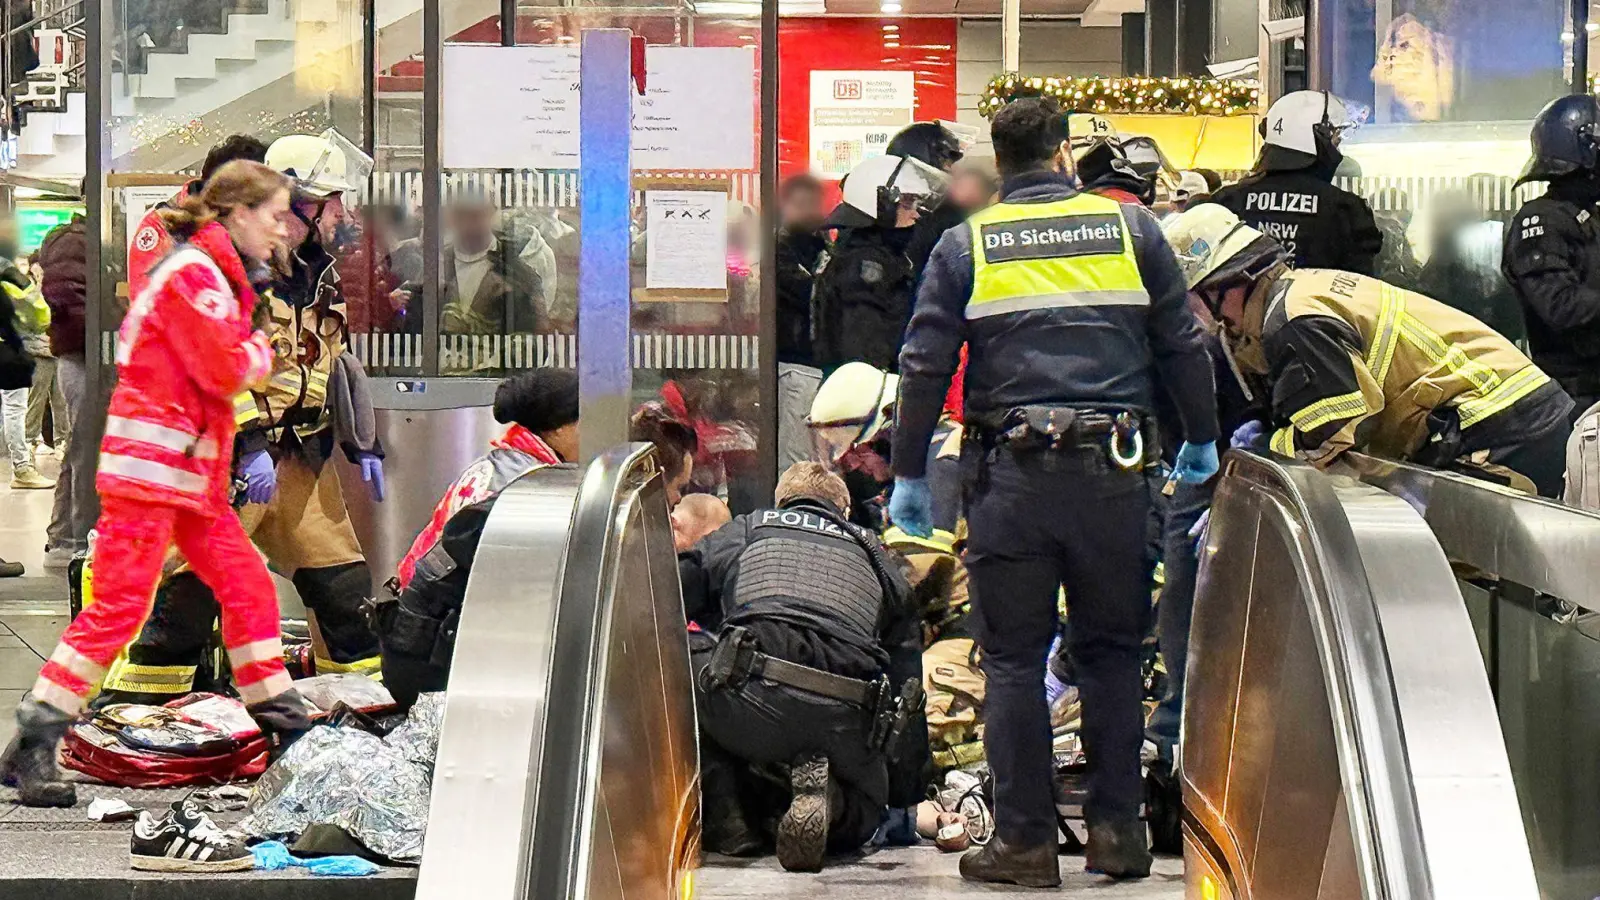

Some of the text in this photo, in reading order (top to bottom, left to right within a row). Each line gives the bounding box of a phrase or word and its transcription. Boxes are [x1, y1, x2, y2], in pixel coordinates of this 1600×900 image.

[837, 81, 859, 97] DB
[1087, 117, 1108, 132] 14
[1272, 117, 1284, 135] 4
[1245, 192, 1319, 214] POLIZEI
[985, 224, 1120, 249] DB Sicherheit
[1258, 221, 1299, 241] NRW
